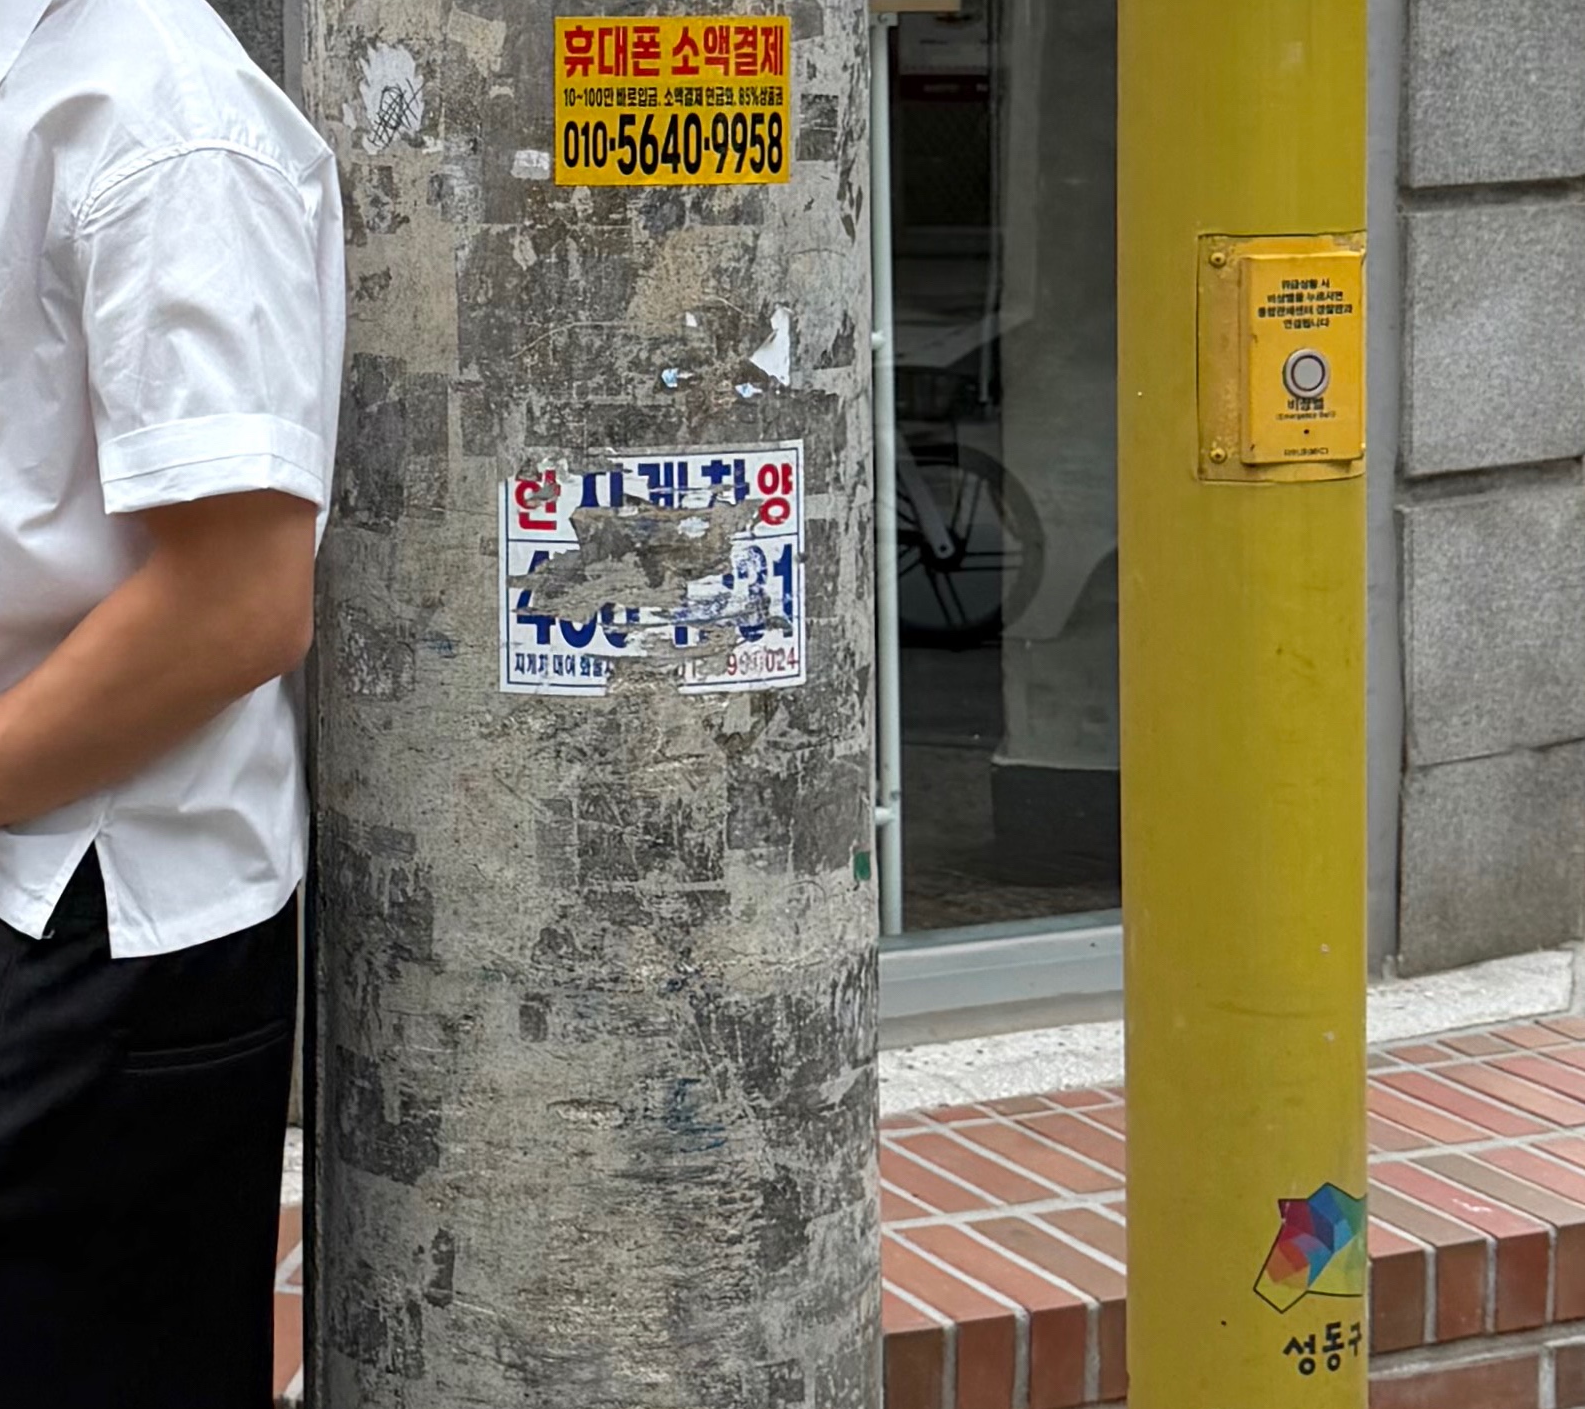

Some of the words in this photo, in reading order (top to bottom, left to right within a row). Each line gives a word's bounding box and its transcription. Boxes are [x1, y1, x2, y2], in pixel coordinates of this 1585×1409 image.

[564, 25, 661, 78] 휴대폰
[671, 25, 784, 76] 소액결제
[1283, 1322, 1362, 1376] 성동구
